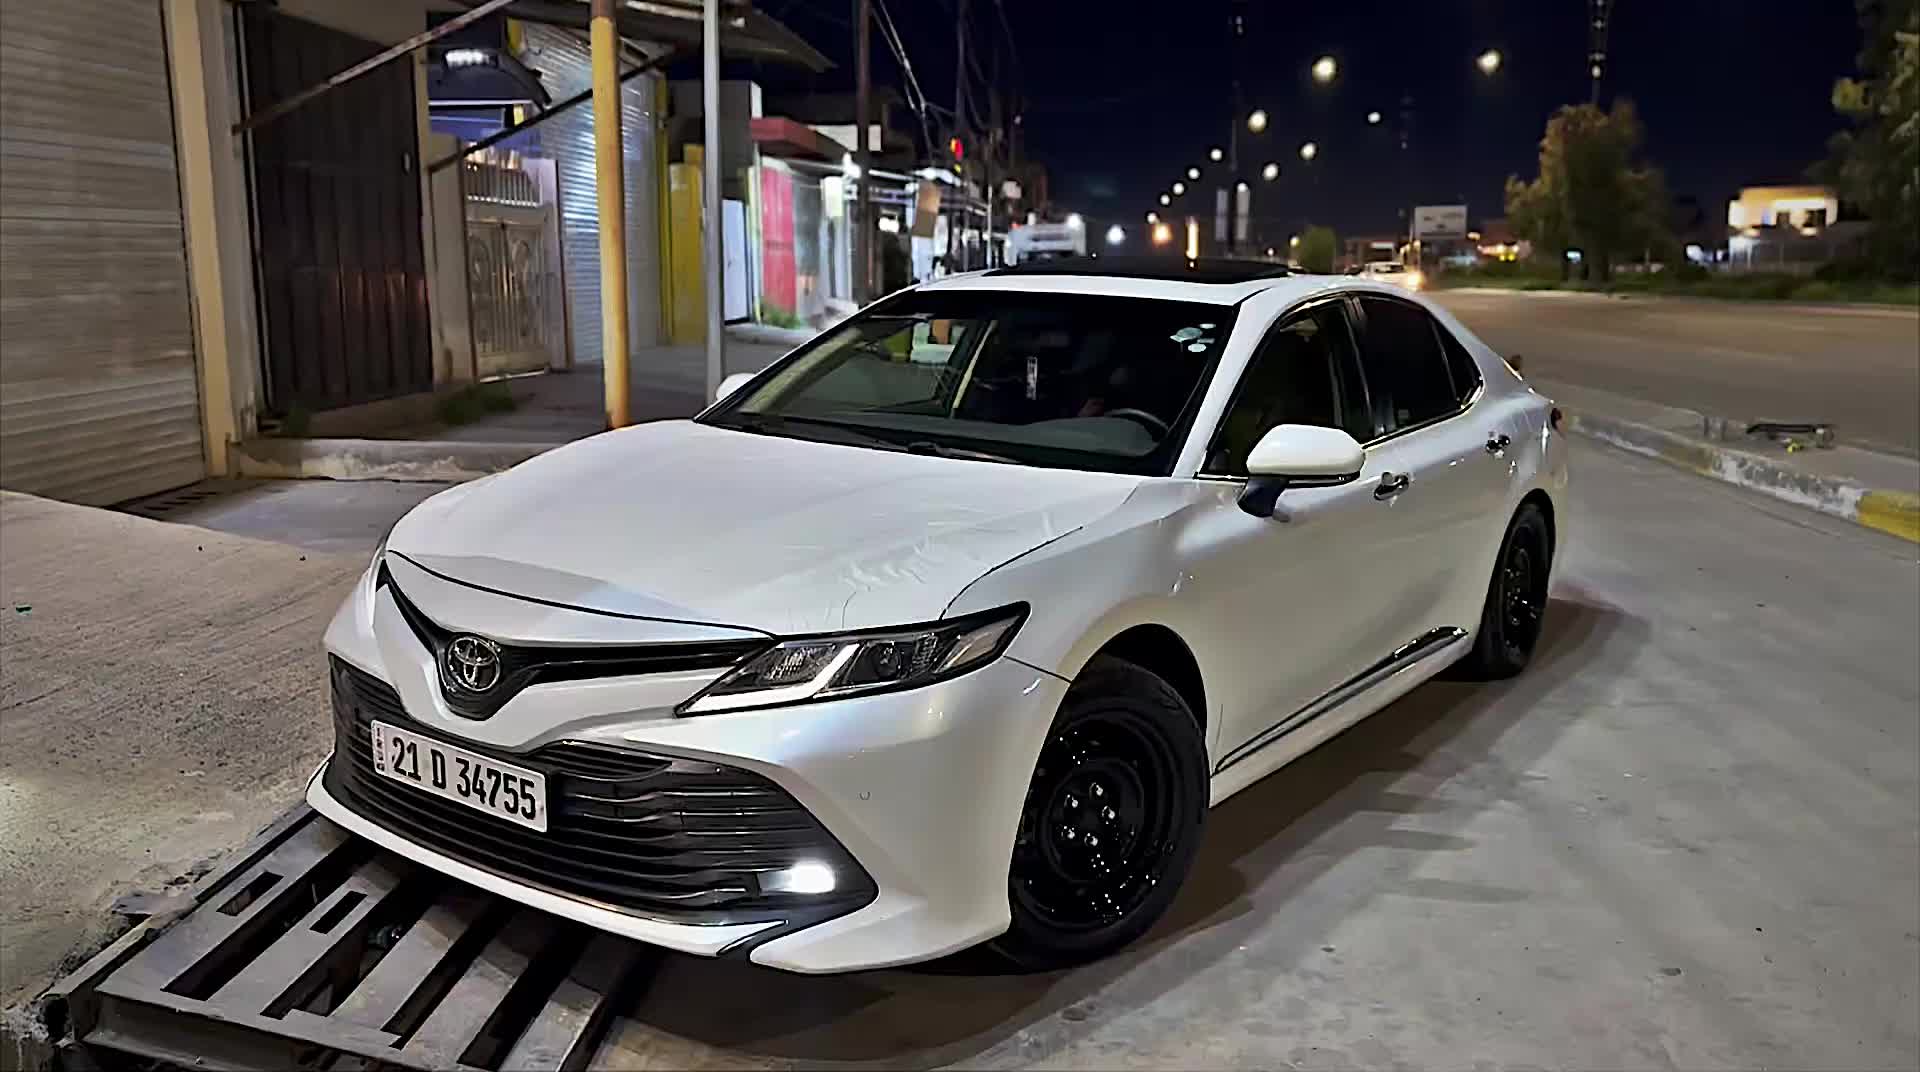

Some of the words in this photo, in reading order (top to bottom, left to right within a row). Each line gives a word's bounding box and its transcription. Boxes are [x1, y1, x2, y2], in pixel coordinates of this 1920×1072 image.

[392, 737, 421, 782] 21
[430, 748, 446, 789] D
[455, 757, 536, 820] 34755
